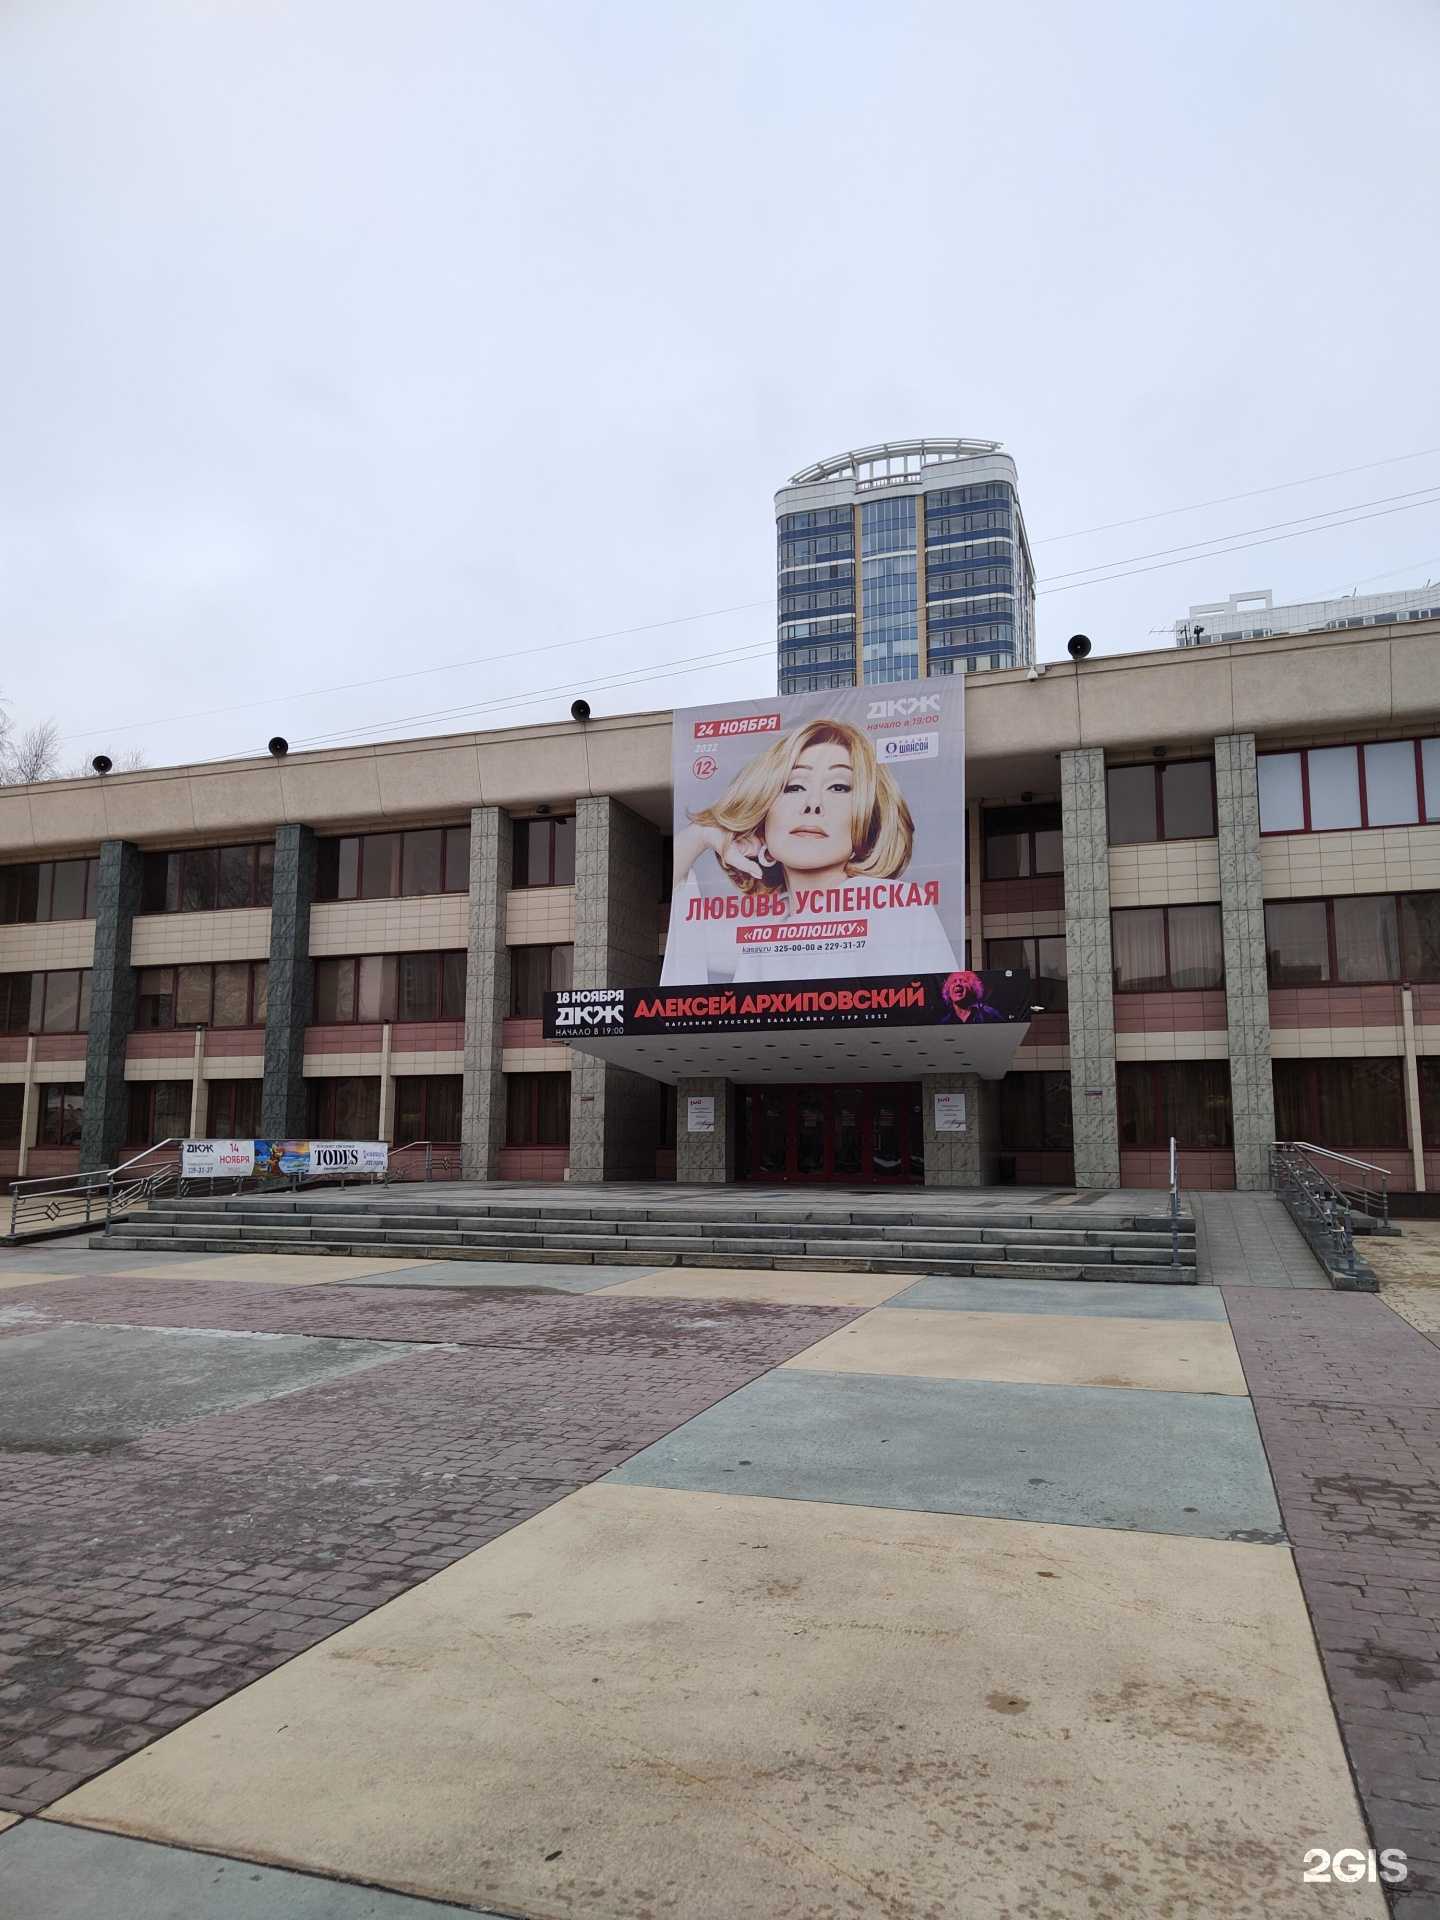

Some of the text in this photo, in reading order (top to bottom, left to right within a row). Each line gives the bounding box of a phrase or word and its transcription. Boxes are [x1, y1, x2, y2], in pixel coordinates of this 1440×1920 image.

[866, 693, 941, 719] ДКЖ
[697, 716, 778, 737] 24 НОЯБРЯ
[695, 760, 719, 776] 12+
[685, 880, 939, 921] ЛЮБОВЬ УСПЕНСКАЯ
[743, 922, 865, 941] «ПО ПОЛЮШКУ»
[774, 943, 815, 953] 325-00-00
[824, 940, 866, 951] 229-31-37
[556, 989, 625, 1004] 18 НОЯБРЯ
[633, 980, 925, 1018] АЛЕКСЕЙ АРХИПОВСКИЙ
[555, 1004, 625, 1026] ДКЖ
[555, 1026, 625, 1037] НАЧАЛО В 19:00
[187, 1144, 214, 1153] ДКЖ
[229, 1143, 239, 1153] 14
[219, 1155, 250, 1164] НОЯБРЯ
[314, 1149, 358, 1166] TODES
